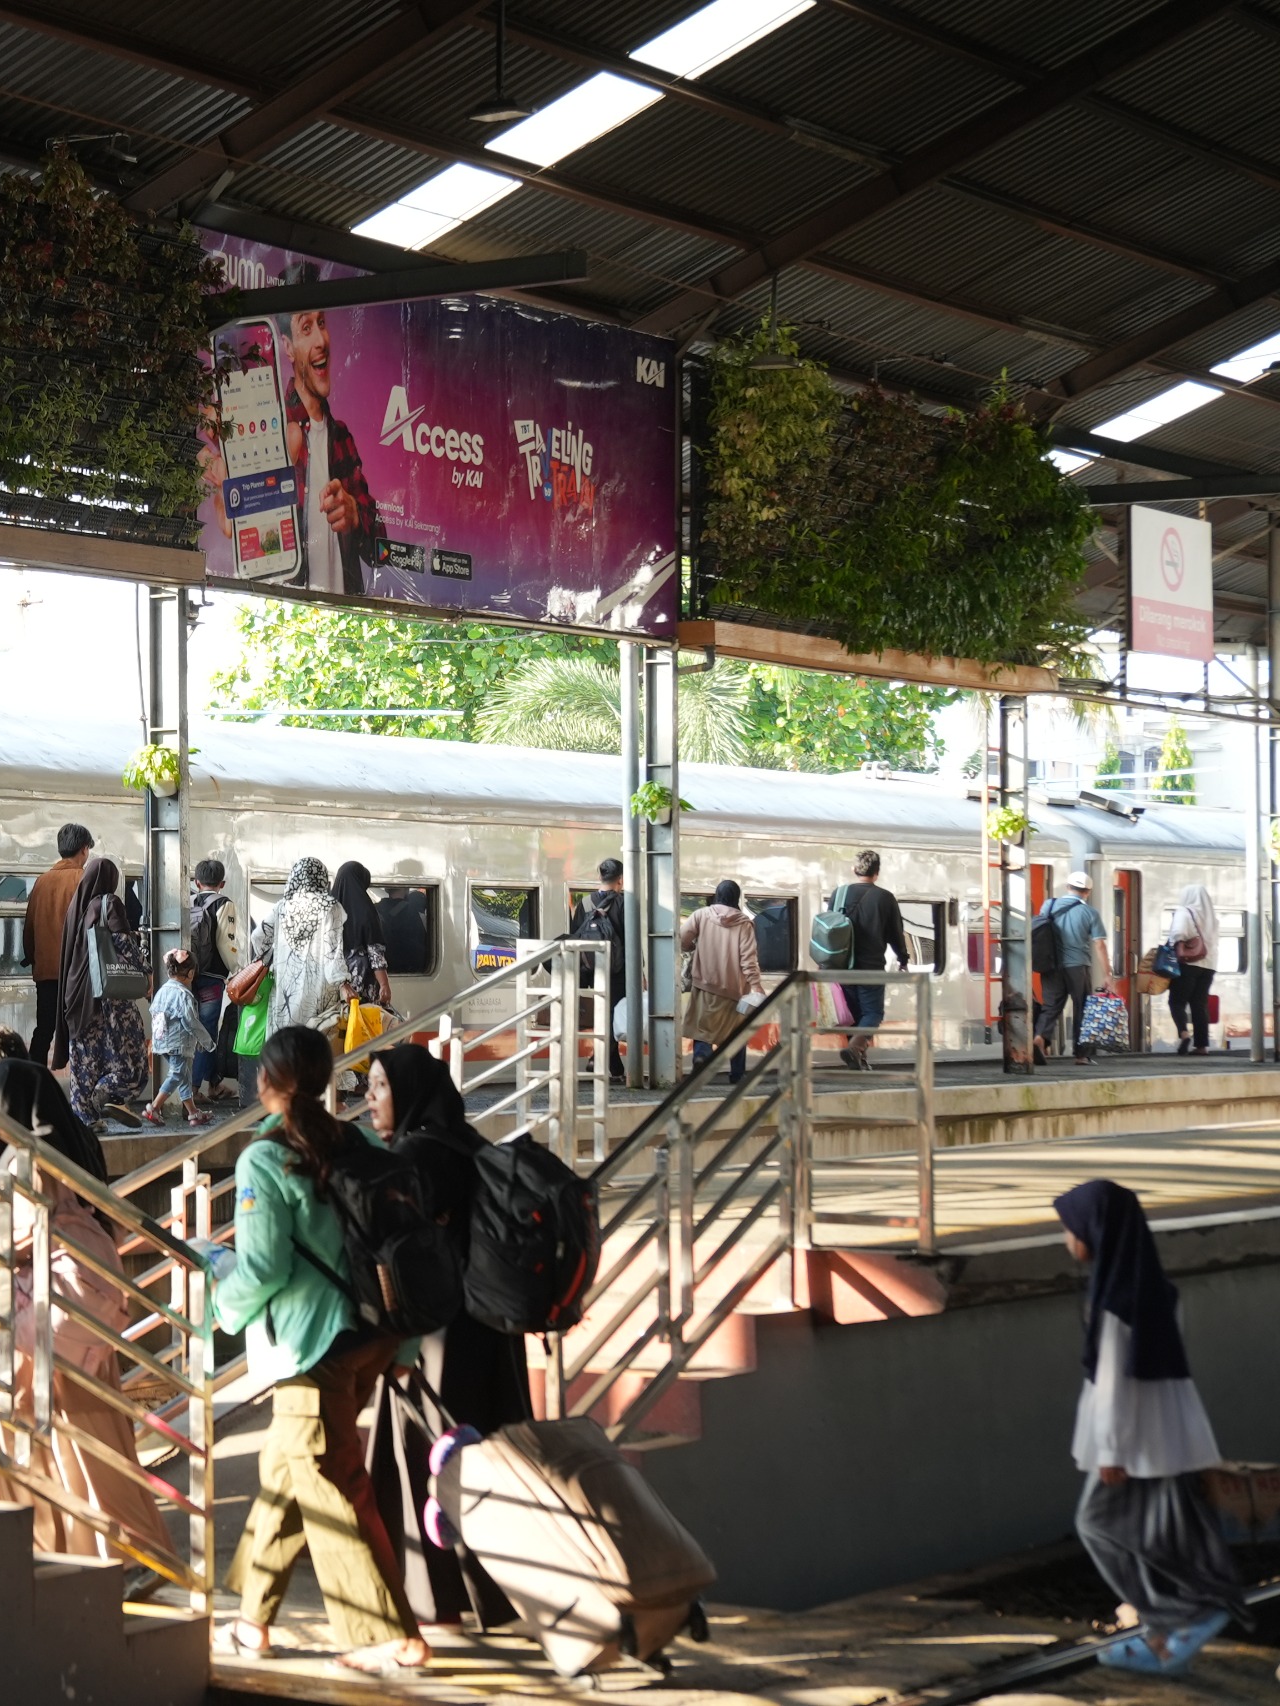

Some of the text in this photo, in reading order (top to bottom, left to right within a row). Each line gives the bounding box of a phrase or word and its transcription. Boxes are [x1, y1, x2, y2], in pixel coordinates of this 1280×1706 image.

[636, 356, 666, 389] KAI
[379, 385, 484, 466] Access
[451, 466, 484, 489] by KAI
[375, 500, 404, 515] Download
[375, 514, 395, 525] Access
[395, 518, 403, 528] by
[404, 518, 414, 528] KAI
[390, 552, 412, 567] Google
[442, 562, 470, 576] App Store
